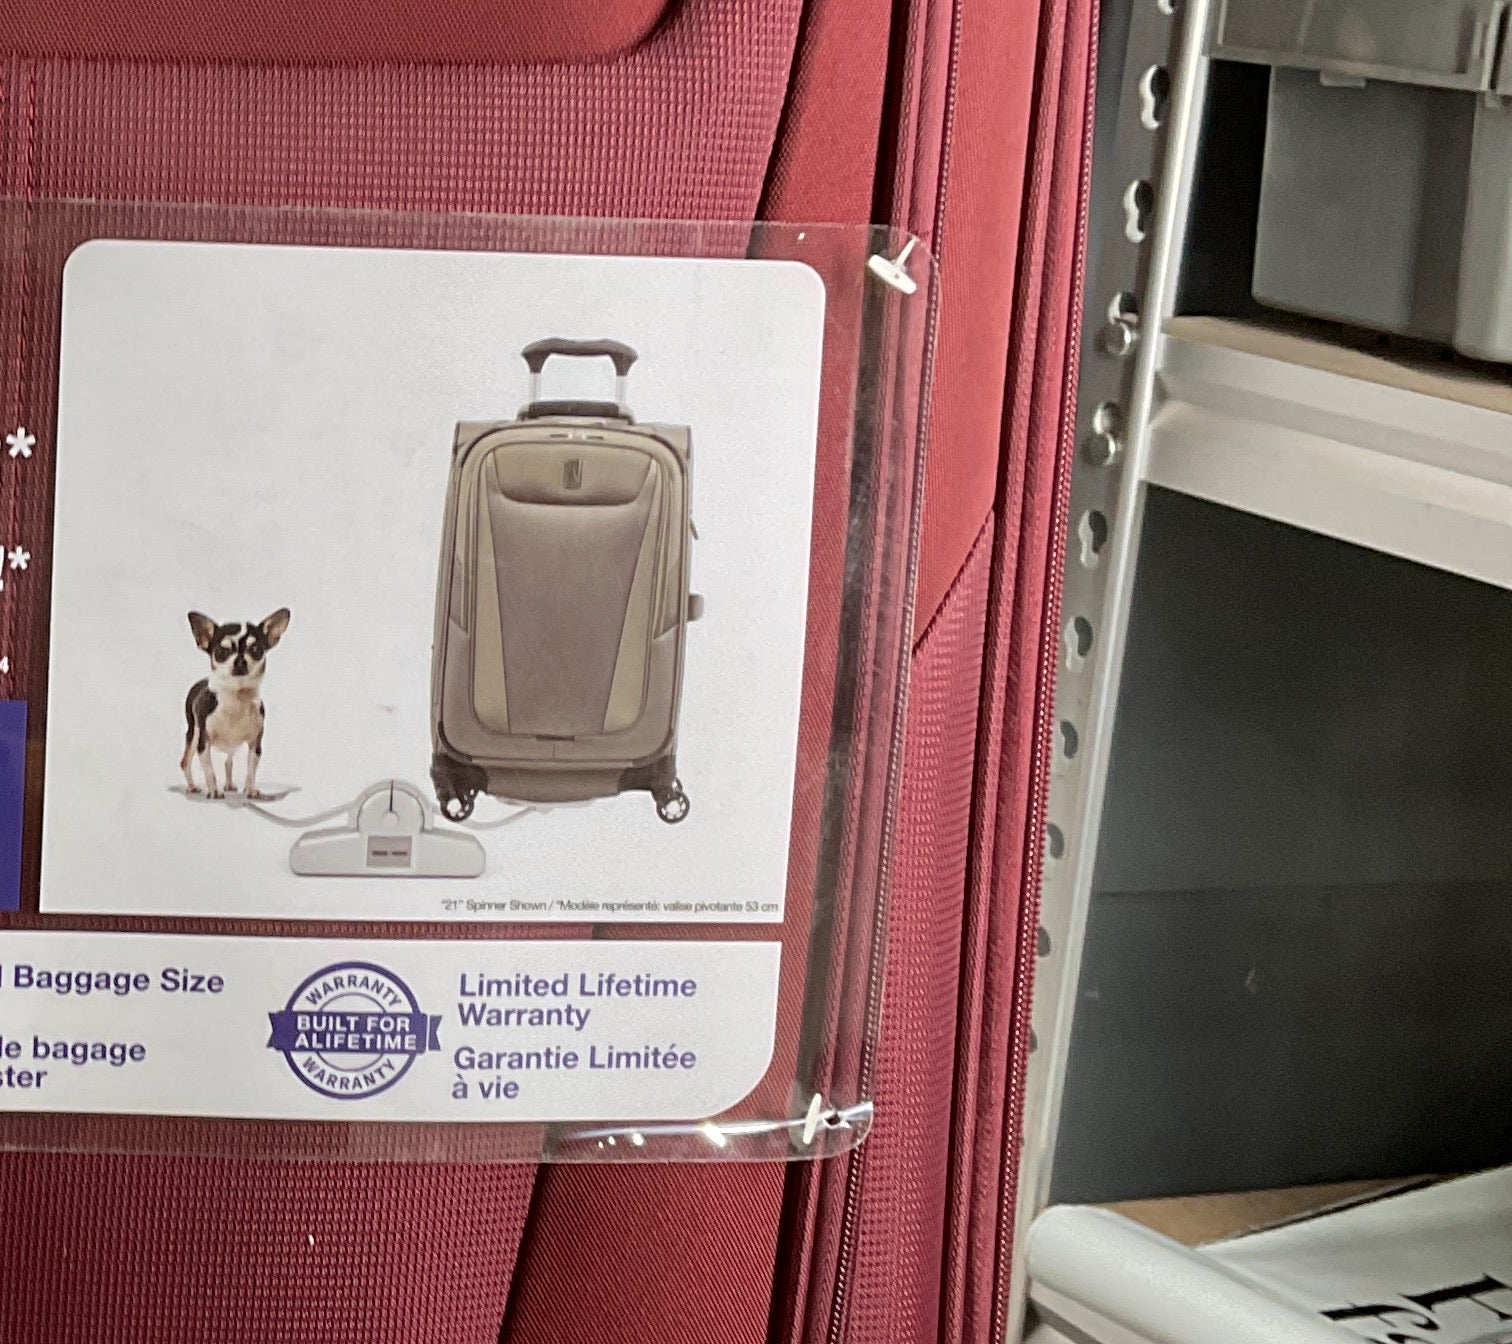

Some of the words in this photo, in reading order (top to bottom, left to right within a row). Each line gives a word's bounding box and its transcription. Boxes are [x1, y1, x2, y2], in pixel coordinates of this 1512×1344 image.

[466, 899, 506, 912] Spinner
[510, 899, 546, 910] Shown
[663, 901, 692, 911] valise
[694, 902, 743, 913] pivotante
[746, 901, 758, 912] 53
[762, 904, 778, 912] cm
[14, 965, 149, 996] Baggage
[161, 968, 224, 993] Size
[304, 973, 403, 1007] WARRANTY
[460, 973, 568, 996] Limited
[580, 973, 696, 997] Lifetime
[297, 1015, 359, 1031] BUILT
[367, 1016, 409, 1032] FOR
[458, 1003, 590, 1031] Warranty
[33, 1036, 145, 1066] bagage
[454, 1046, 578, 1070] Garantie
[590, 1044, 696, 1069] Limitée
[301, 1055, 396, 1091] WARRANTY
[452, 1075, 467, 1099] à
[479, 1082, 519, 1099] vie
